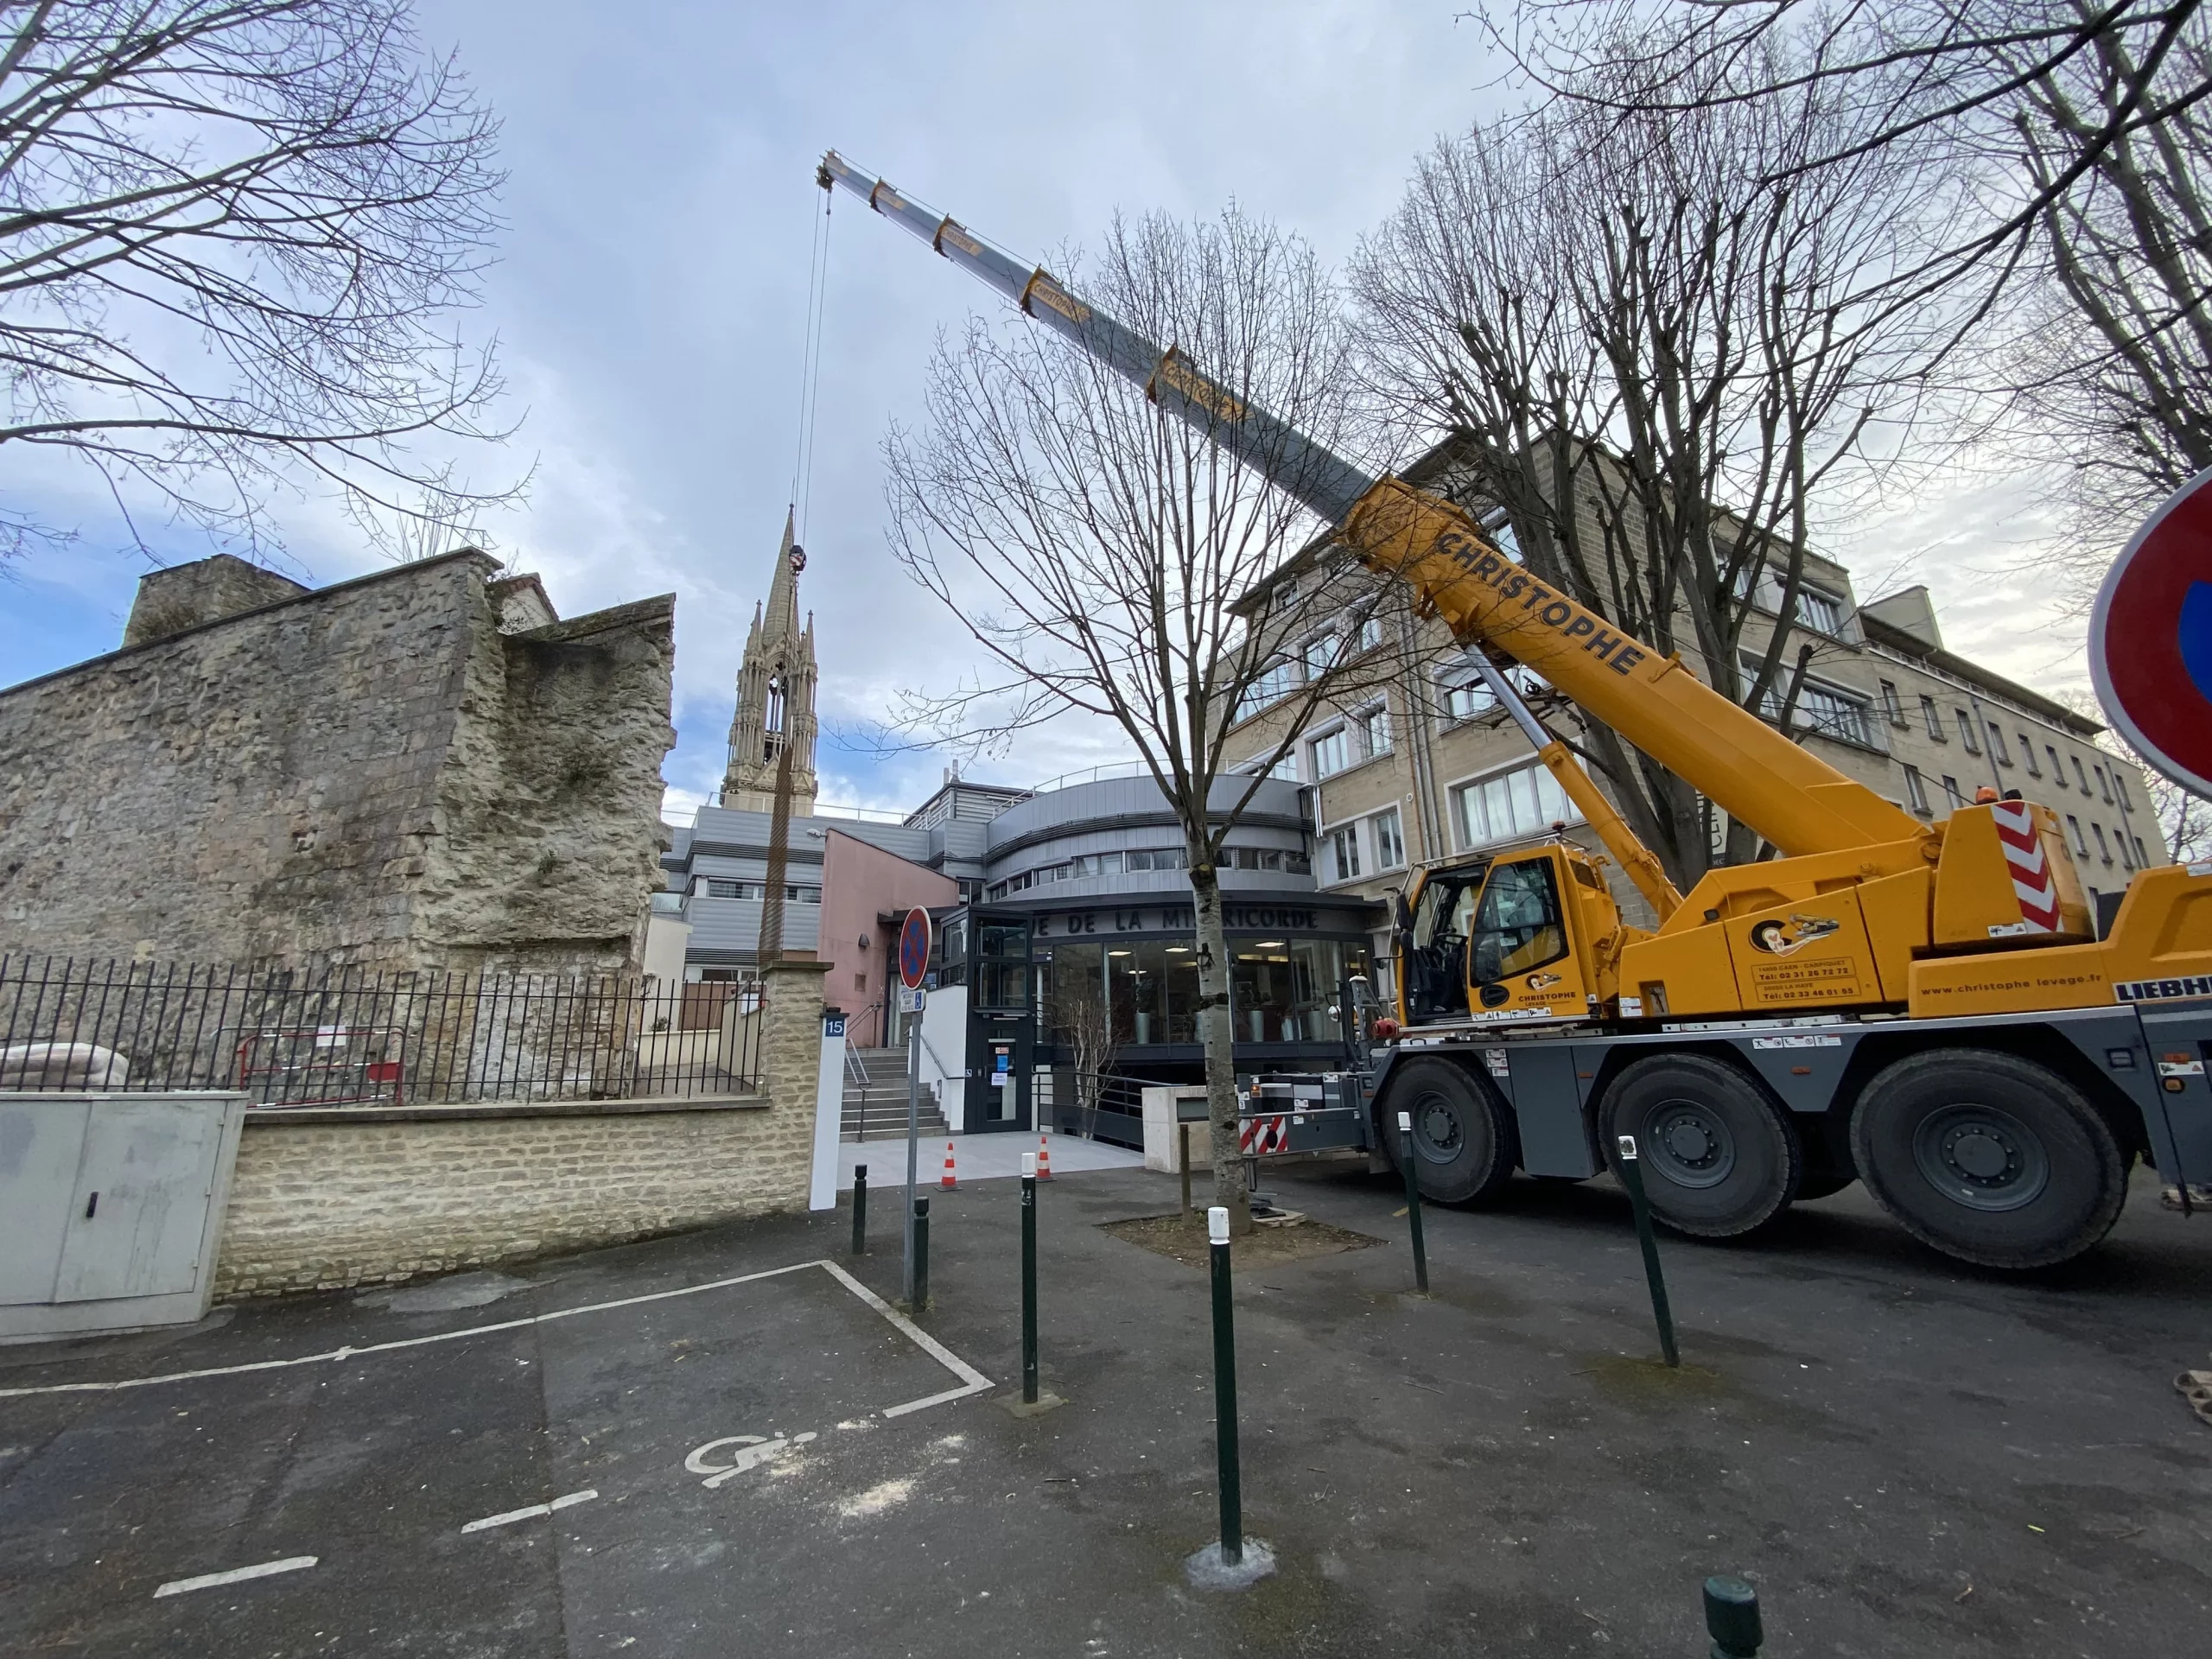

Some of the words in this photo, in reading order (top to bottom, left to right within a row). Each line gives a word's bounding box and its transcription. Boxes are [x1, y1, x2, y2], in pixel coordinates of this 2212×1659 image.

[1433, 532, 1646, 677] CHRISTOPHE
[1067, 913, 1096, 933] DE
[1116, 909, 1141, 931] LA
[1163, 908, 1319, 930] MIRICORDE
[1518, 991, 1576, 1002] CHRISTOPHE
[2116, 976, 2212, 1001] LIEBH
[827, 1020, 843, 1033] 15
